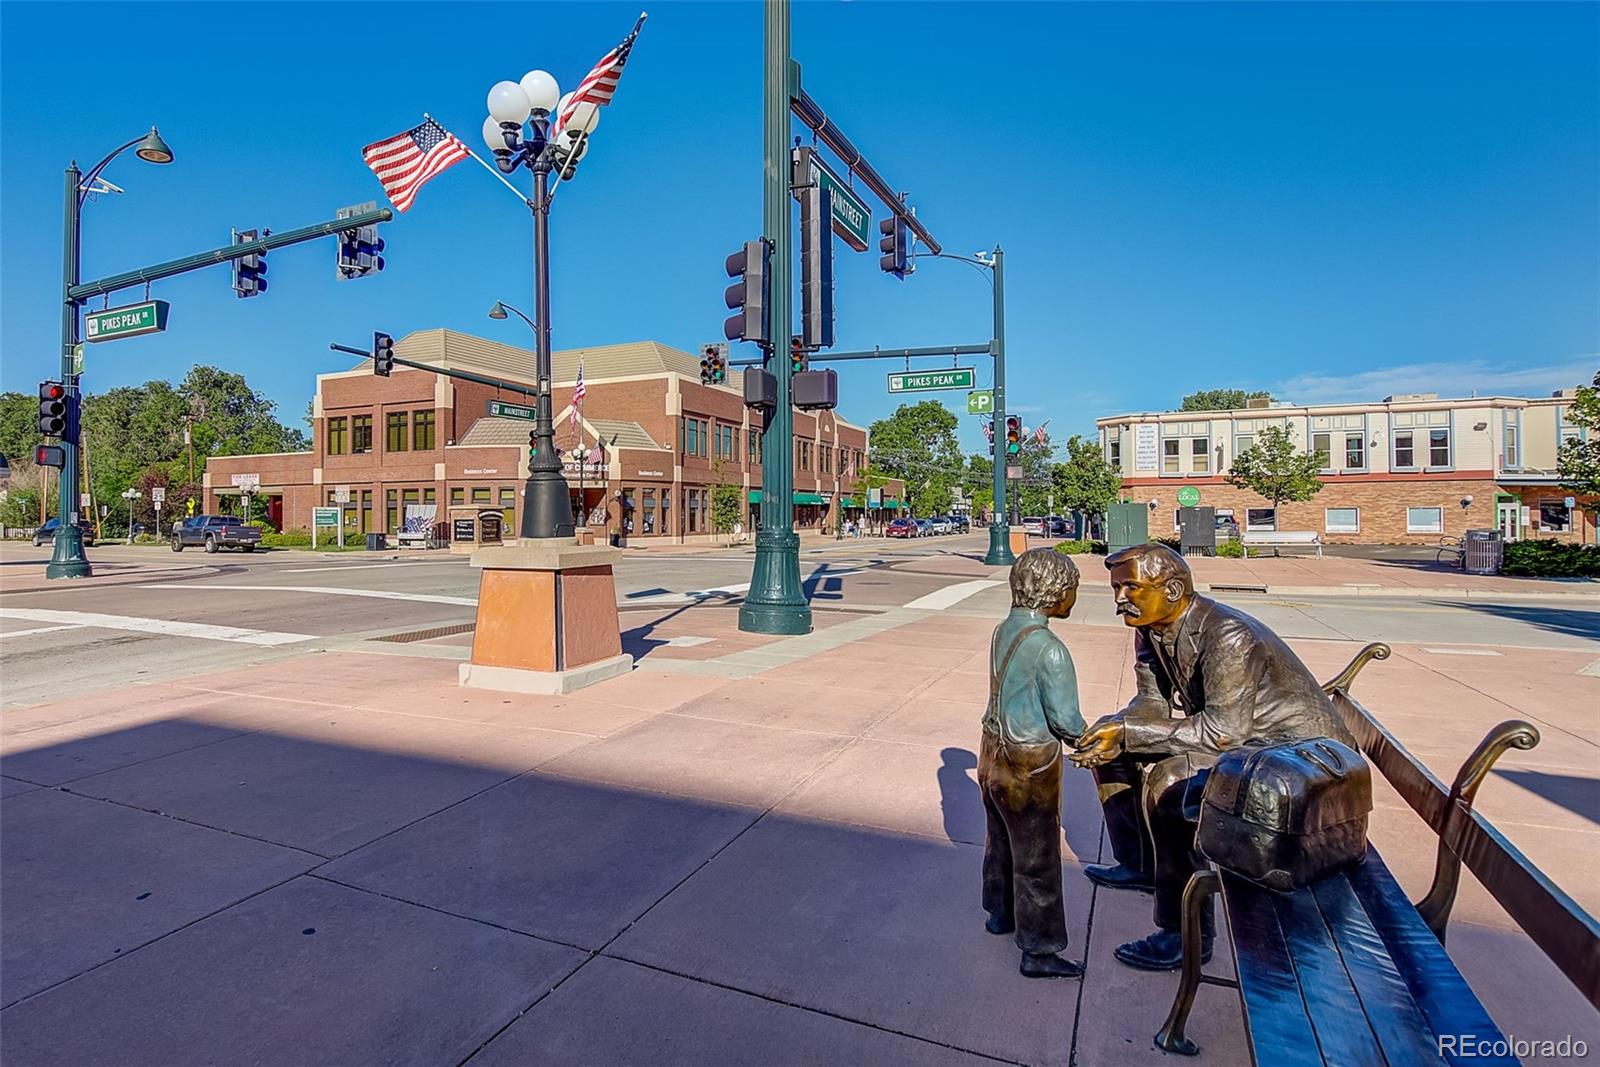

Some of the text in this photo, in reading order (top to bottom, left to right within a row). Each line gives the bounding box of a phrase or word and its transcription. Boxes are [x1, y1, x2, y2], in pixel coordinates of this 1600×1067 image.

[102, 316, 120, 331] PIKES
[121, 312, 141, 327] PEAK
[907, 377, 930, 387] PIKES
[933, 375, 955, 385] PEAK
[977, 395, 990, 409] P
[504, 407, 530, 417] MAINSTREET
